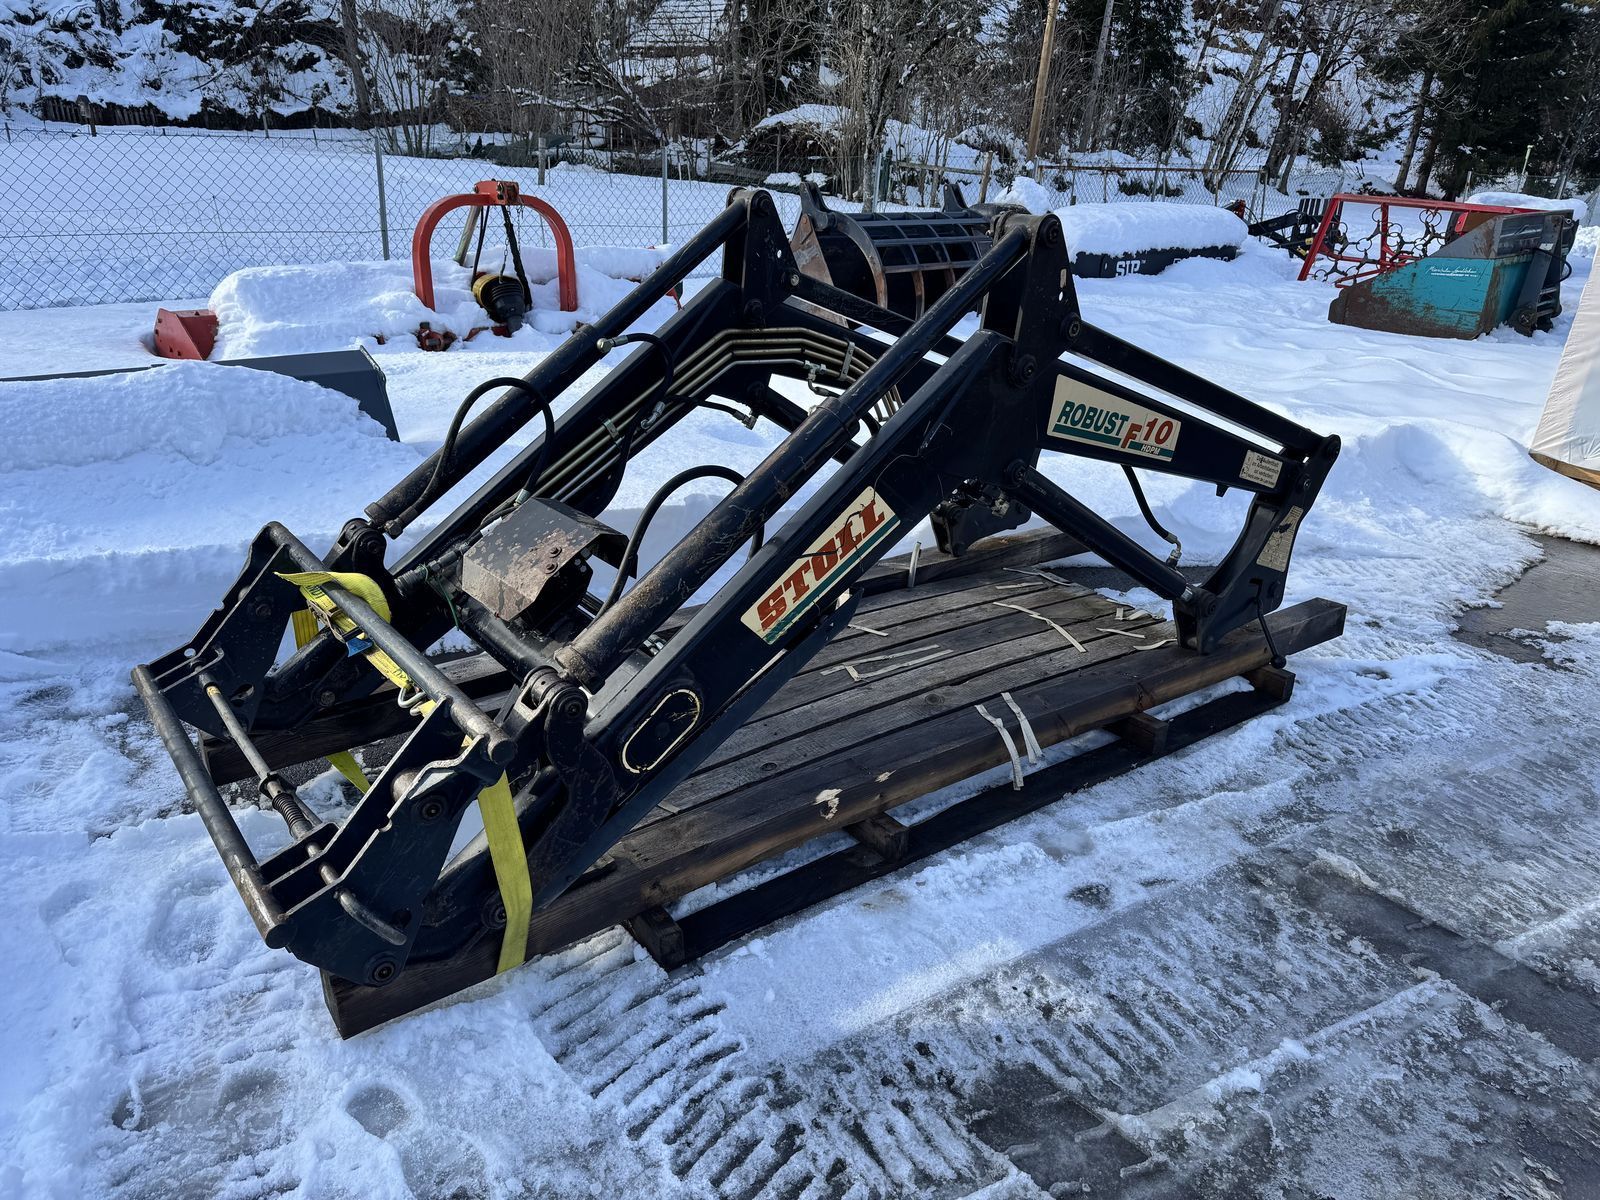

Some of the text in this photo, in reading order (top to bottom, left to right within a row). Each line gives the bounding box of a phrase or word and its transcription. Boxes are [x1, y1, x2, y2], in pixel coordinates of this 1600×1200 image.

[1115, 259, 1141, 277] SIP
[1056, 399, 1130, 437] ROBUST
[756, 499, 886, 632] STOLL
